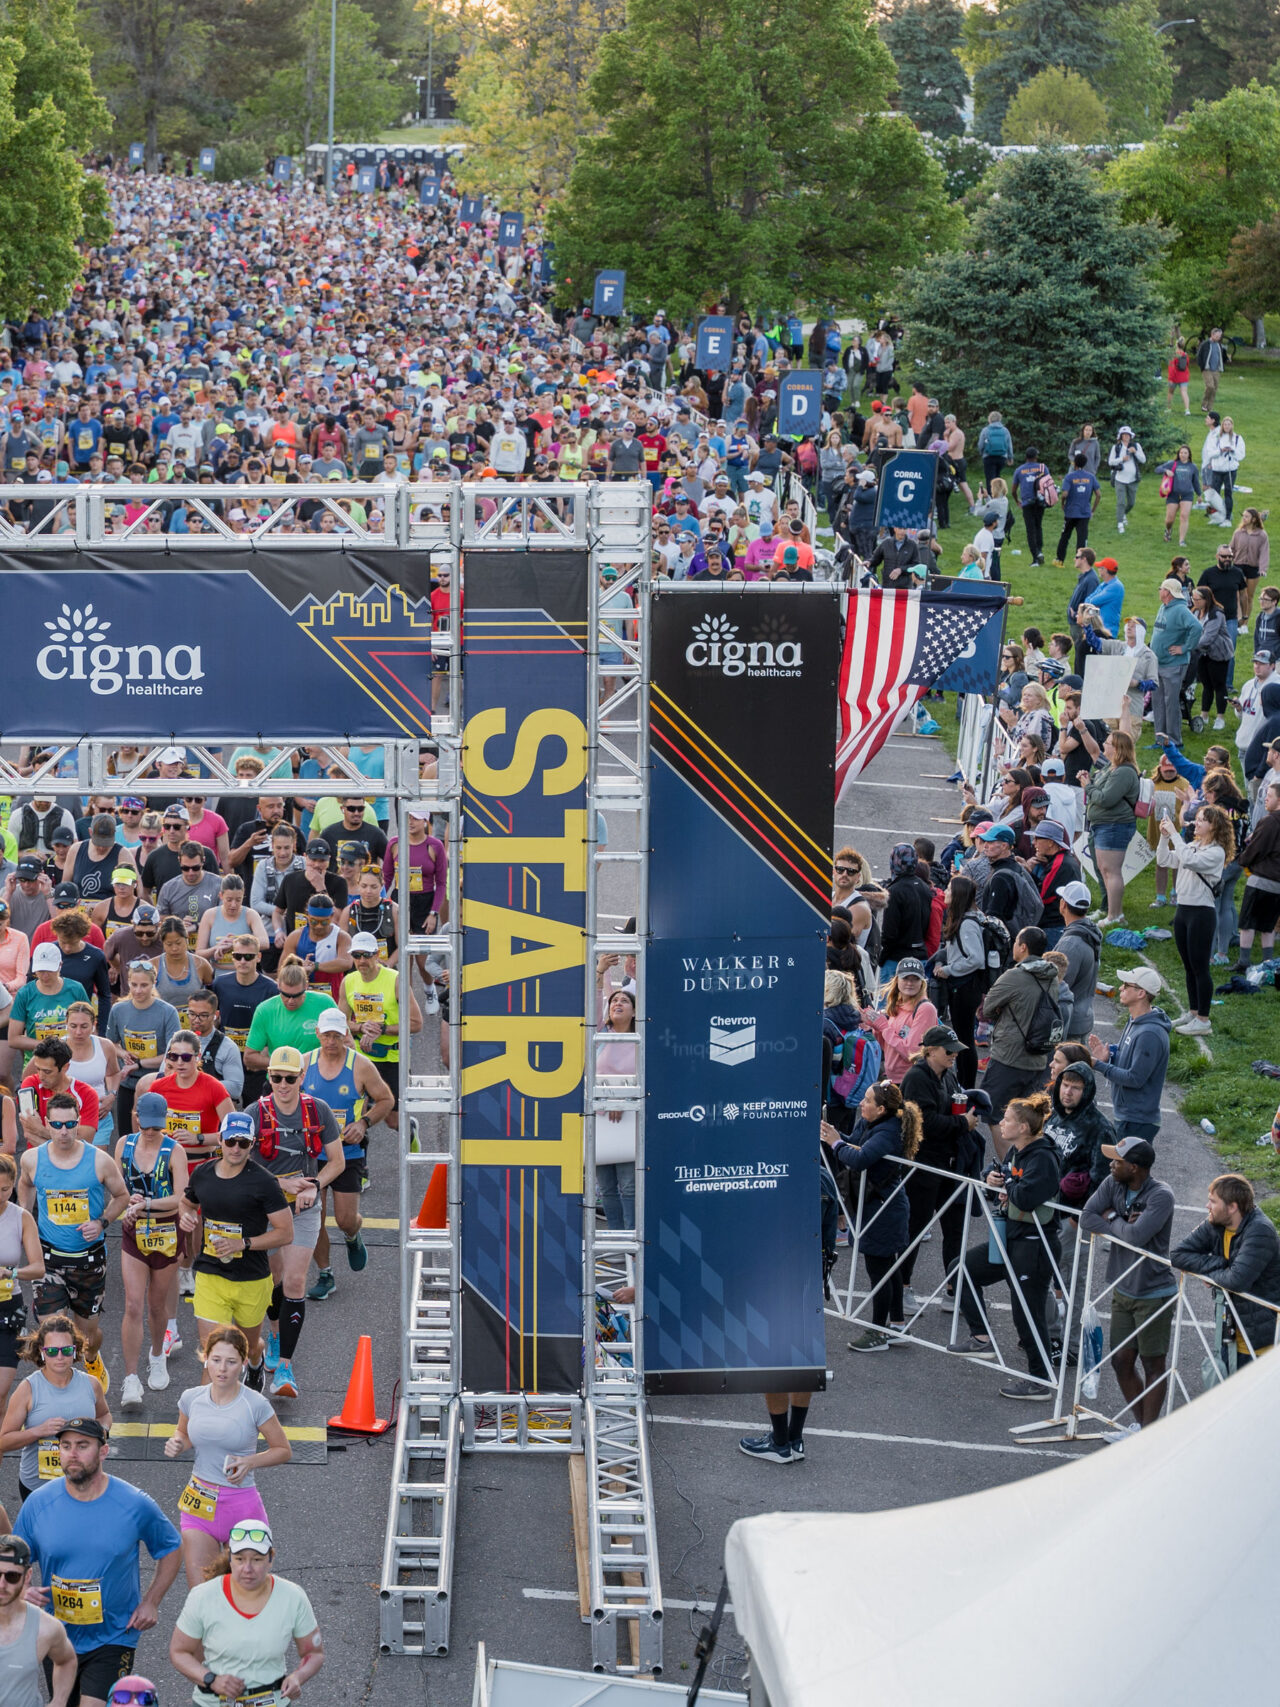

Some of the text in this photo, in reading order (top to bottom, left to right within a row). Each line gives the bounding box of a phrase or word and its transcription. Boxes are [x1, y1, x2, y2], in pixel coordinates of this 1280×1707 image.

[279, 164, 285, 174] L
[427, 187, 434, 197] J
[470, 202, 474, 213] I
[506, 225, 516, 237] H
[604, 287, 614, 302] F
[708, 336, 720, 354] E
[787, 383, 814, 391] CORRAL
[792, 395, 808, 416] D
[894, 470, 923, 480] CORRAL
[897, 480, 916, 503] C
[685, 641, 804, 677] cigna
[36, 643, 206, 695] cigna
[747, 667, 802, 678] healthcare
[126, 683, 203, 696] healthcare
[462, 707, 588, 1194] START
[682, 955, 796, 972] WALKER &
[683, 975, 779, 993] DUNLOP
[355, 1003, 373, 1012] 1563
[710, 1016, 757, 1027] Chevron
[743, 1101, 808, 1111] KEEP DRIVING
[658, 1111, 690, 1120] GROOVE
[743, 1110, 808, 1120] FOUNDATION
[685, 1178, 778, 1193] denverpost.com
[53, 1203, 76, 1213] 1144
[56, 1593, 84, 1609] 1264
